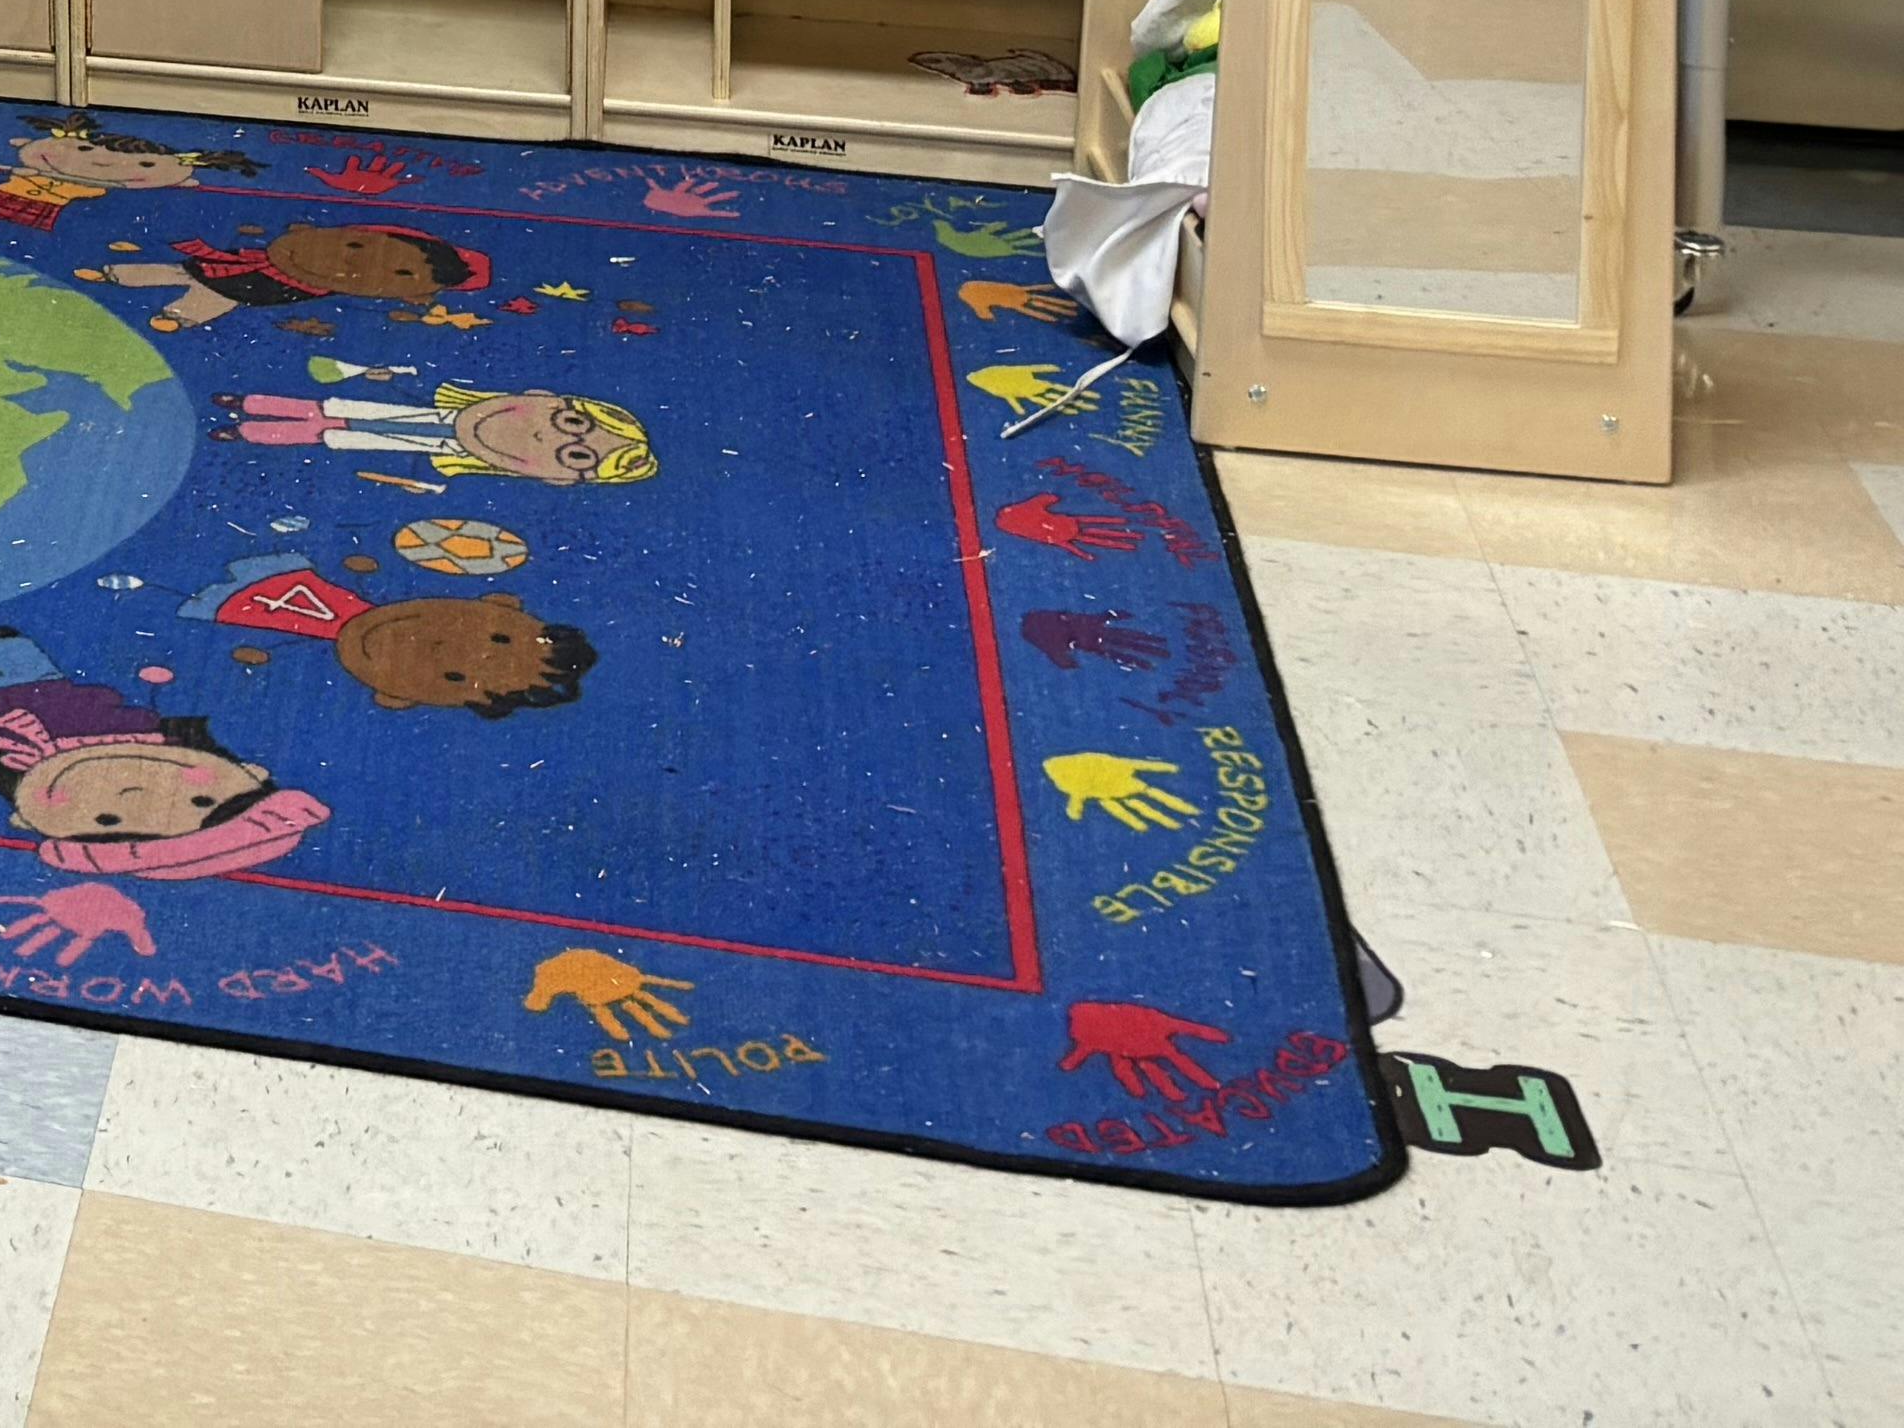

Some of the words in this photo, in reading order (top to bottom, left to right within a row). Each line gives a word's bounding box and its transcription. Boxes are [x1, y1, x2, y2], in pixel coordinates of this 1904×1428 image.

[297, 95, 369, 113] KAPLAN
[773, 133, 846, 152] KAPLAN
[1091, 725, 1268, 924] RESPONSIBLE
[219, 938, 396, 1004] HARD
[589, 1032, 827, 1080] POLITE
[1048, 1030, 1351, 1154] EDUCATED
